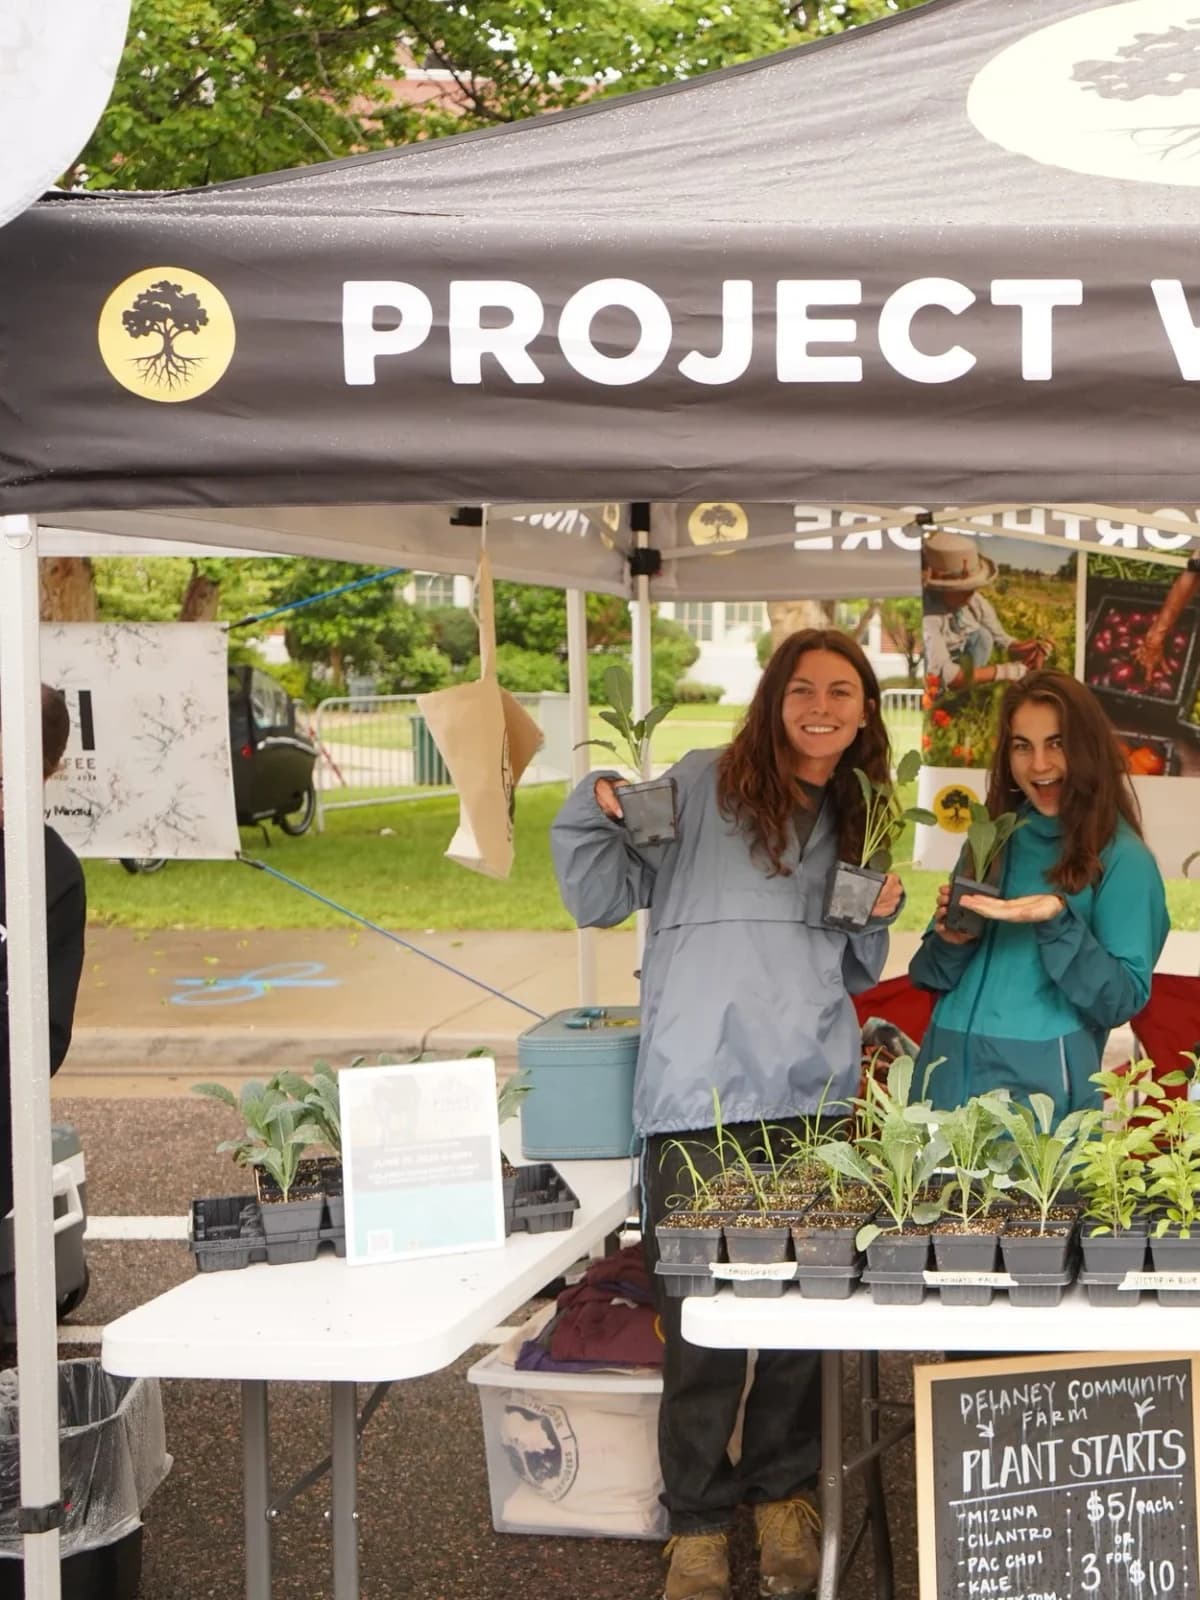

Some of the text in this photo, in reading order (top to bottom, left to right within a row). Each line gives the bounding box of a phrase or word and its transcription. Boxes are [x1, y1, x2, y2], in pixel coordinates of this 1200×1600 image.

[342, 277, 1083, 386] PROJECT
[960, 1374, 1187, 1417] DELANEY COMMUNITY
[1022, 1407, 1088, 1430] FARM
[962, 1429, 1188, 1493] PLANT STARTS
[967, 1550, 1044, 1574] PAC CHOI
[1081, 1553, 1174, 1596] 3 FOR $10
[968, 1576, 1012, 1595] KALE
